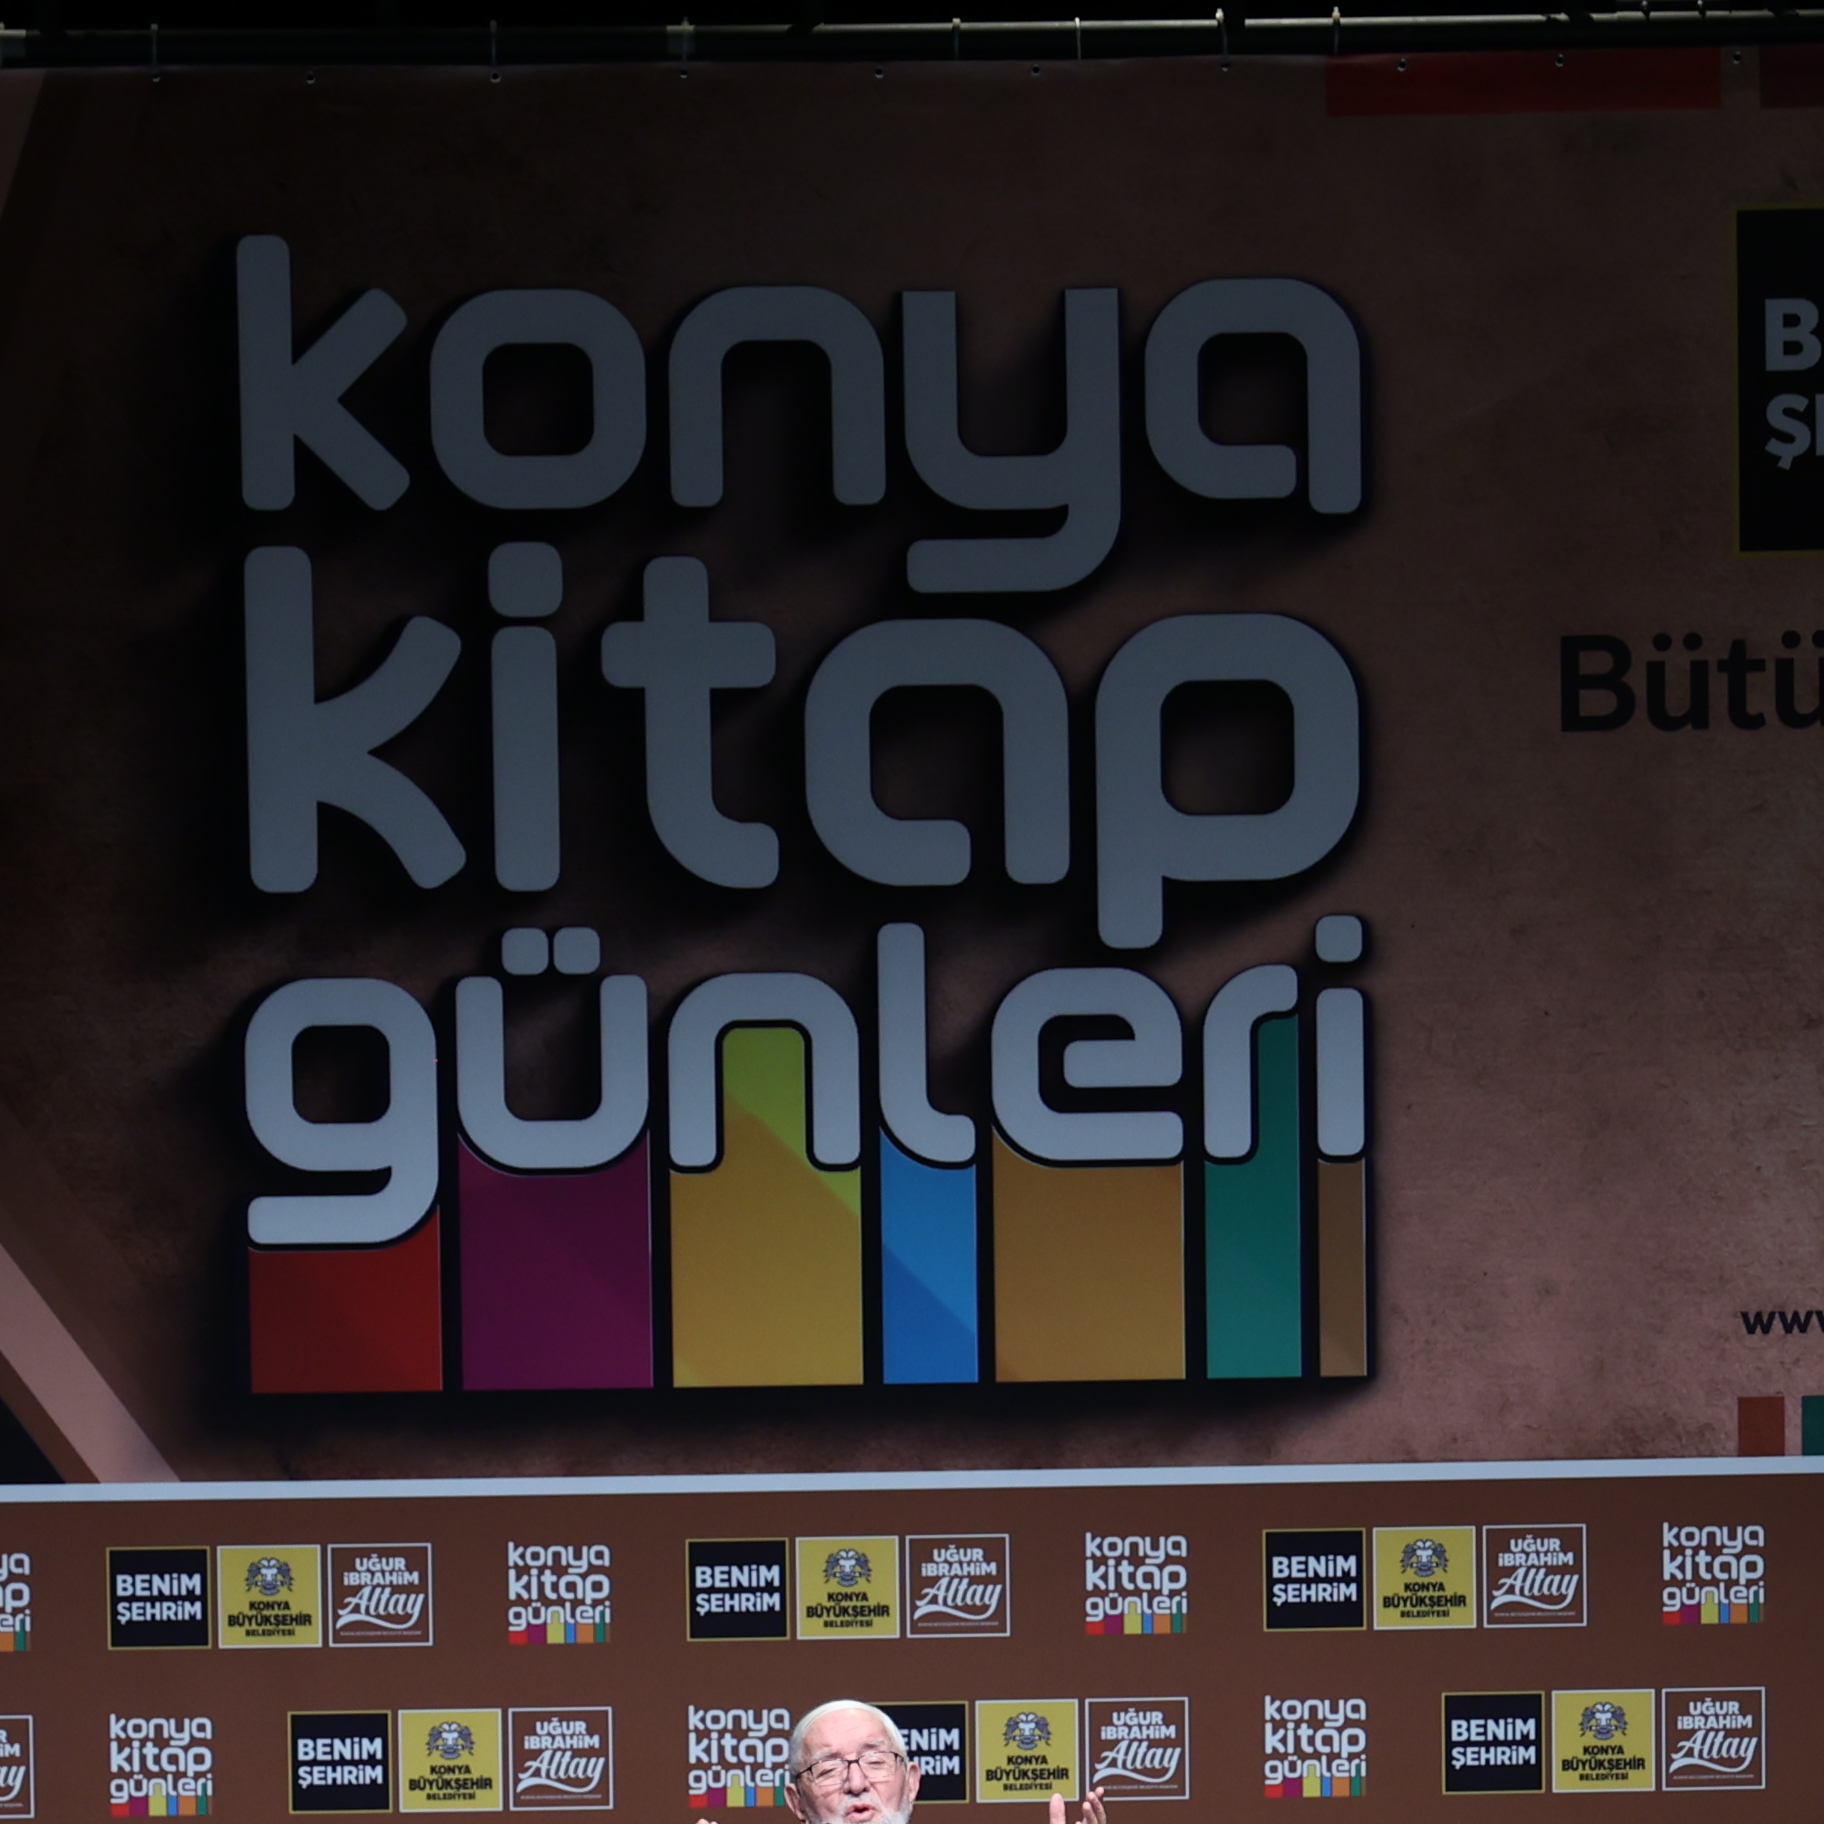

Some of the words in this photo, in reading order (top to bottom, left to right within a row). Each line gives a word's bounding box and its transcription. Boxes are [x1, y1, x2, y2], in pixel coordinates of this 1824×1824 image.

[236, 235, 1362, 593] konya
[244, 541, 1360, 949] kitap
[245, 915, 1365, 1245] günleri
[1085, 1532, 1188, 1564] konya
[1510, 1534, 1561, 1552] UĞUR
[1085, 1558, 1188, 1596] kitap
[1404, 1582, 1446, 1593] KONYA
[1490, 1566, 1580, 1610] Altay
[1085, 1591, 1188, 1622] günleri
[688, 1704, 790, 1737] konya
[688, 1731, 790, 1769] kitap
[688, 1764, 790, 1795] günleri
